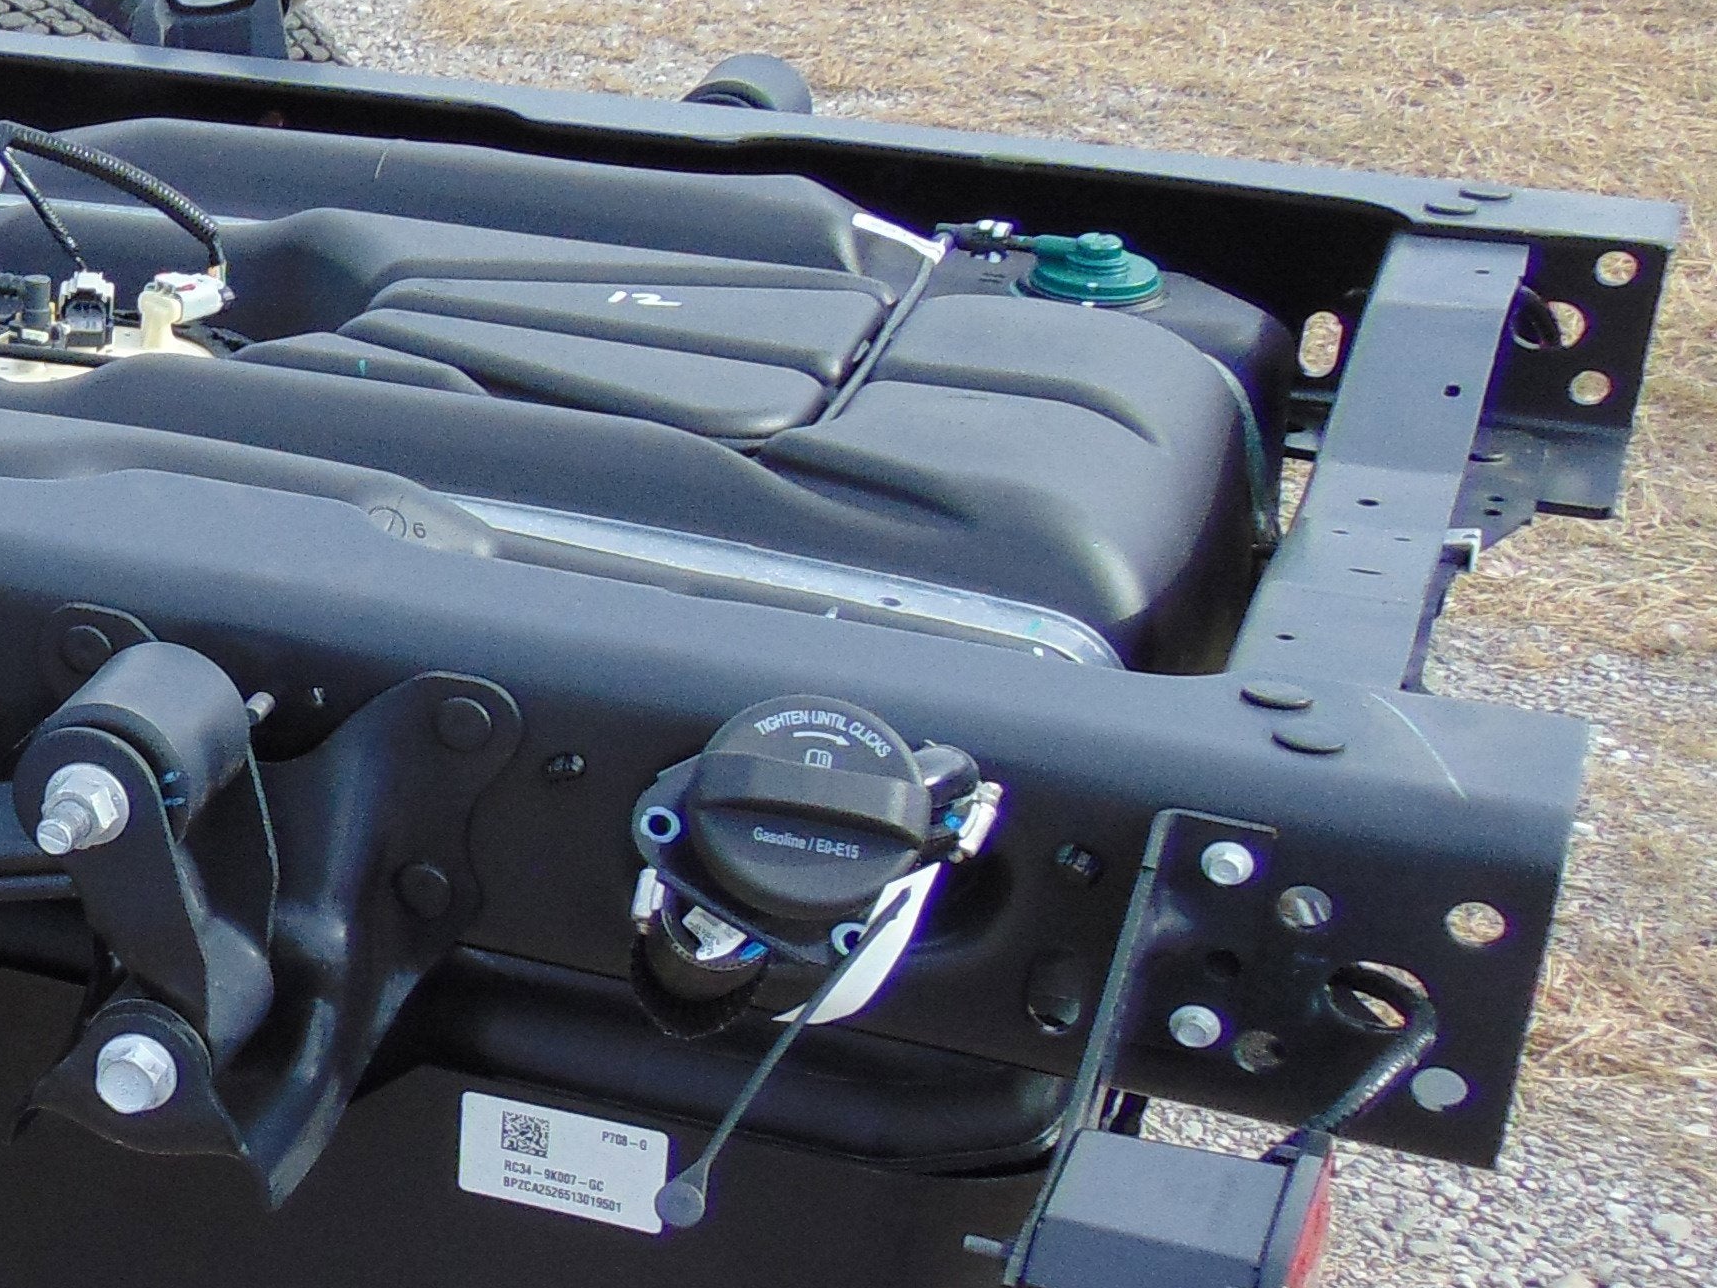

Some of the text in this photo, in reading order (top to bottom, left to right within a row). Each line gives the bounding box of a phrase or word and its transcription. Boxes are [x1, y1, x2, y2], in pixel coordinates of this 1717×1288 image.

[753, 709, 892, 759] TIGHTEN UNTIL CLICKS
[753, 825, 807, 850] Gasoline
